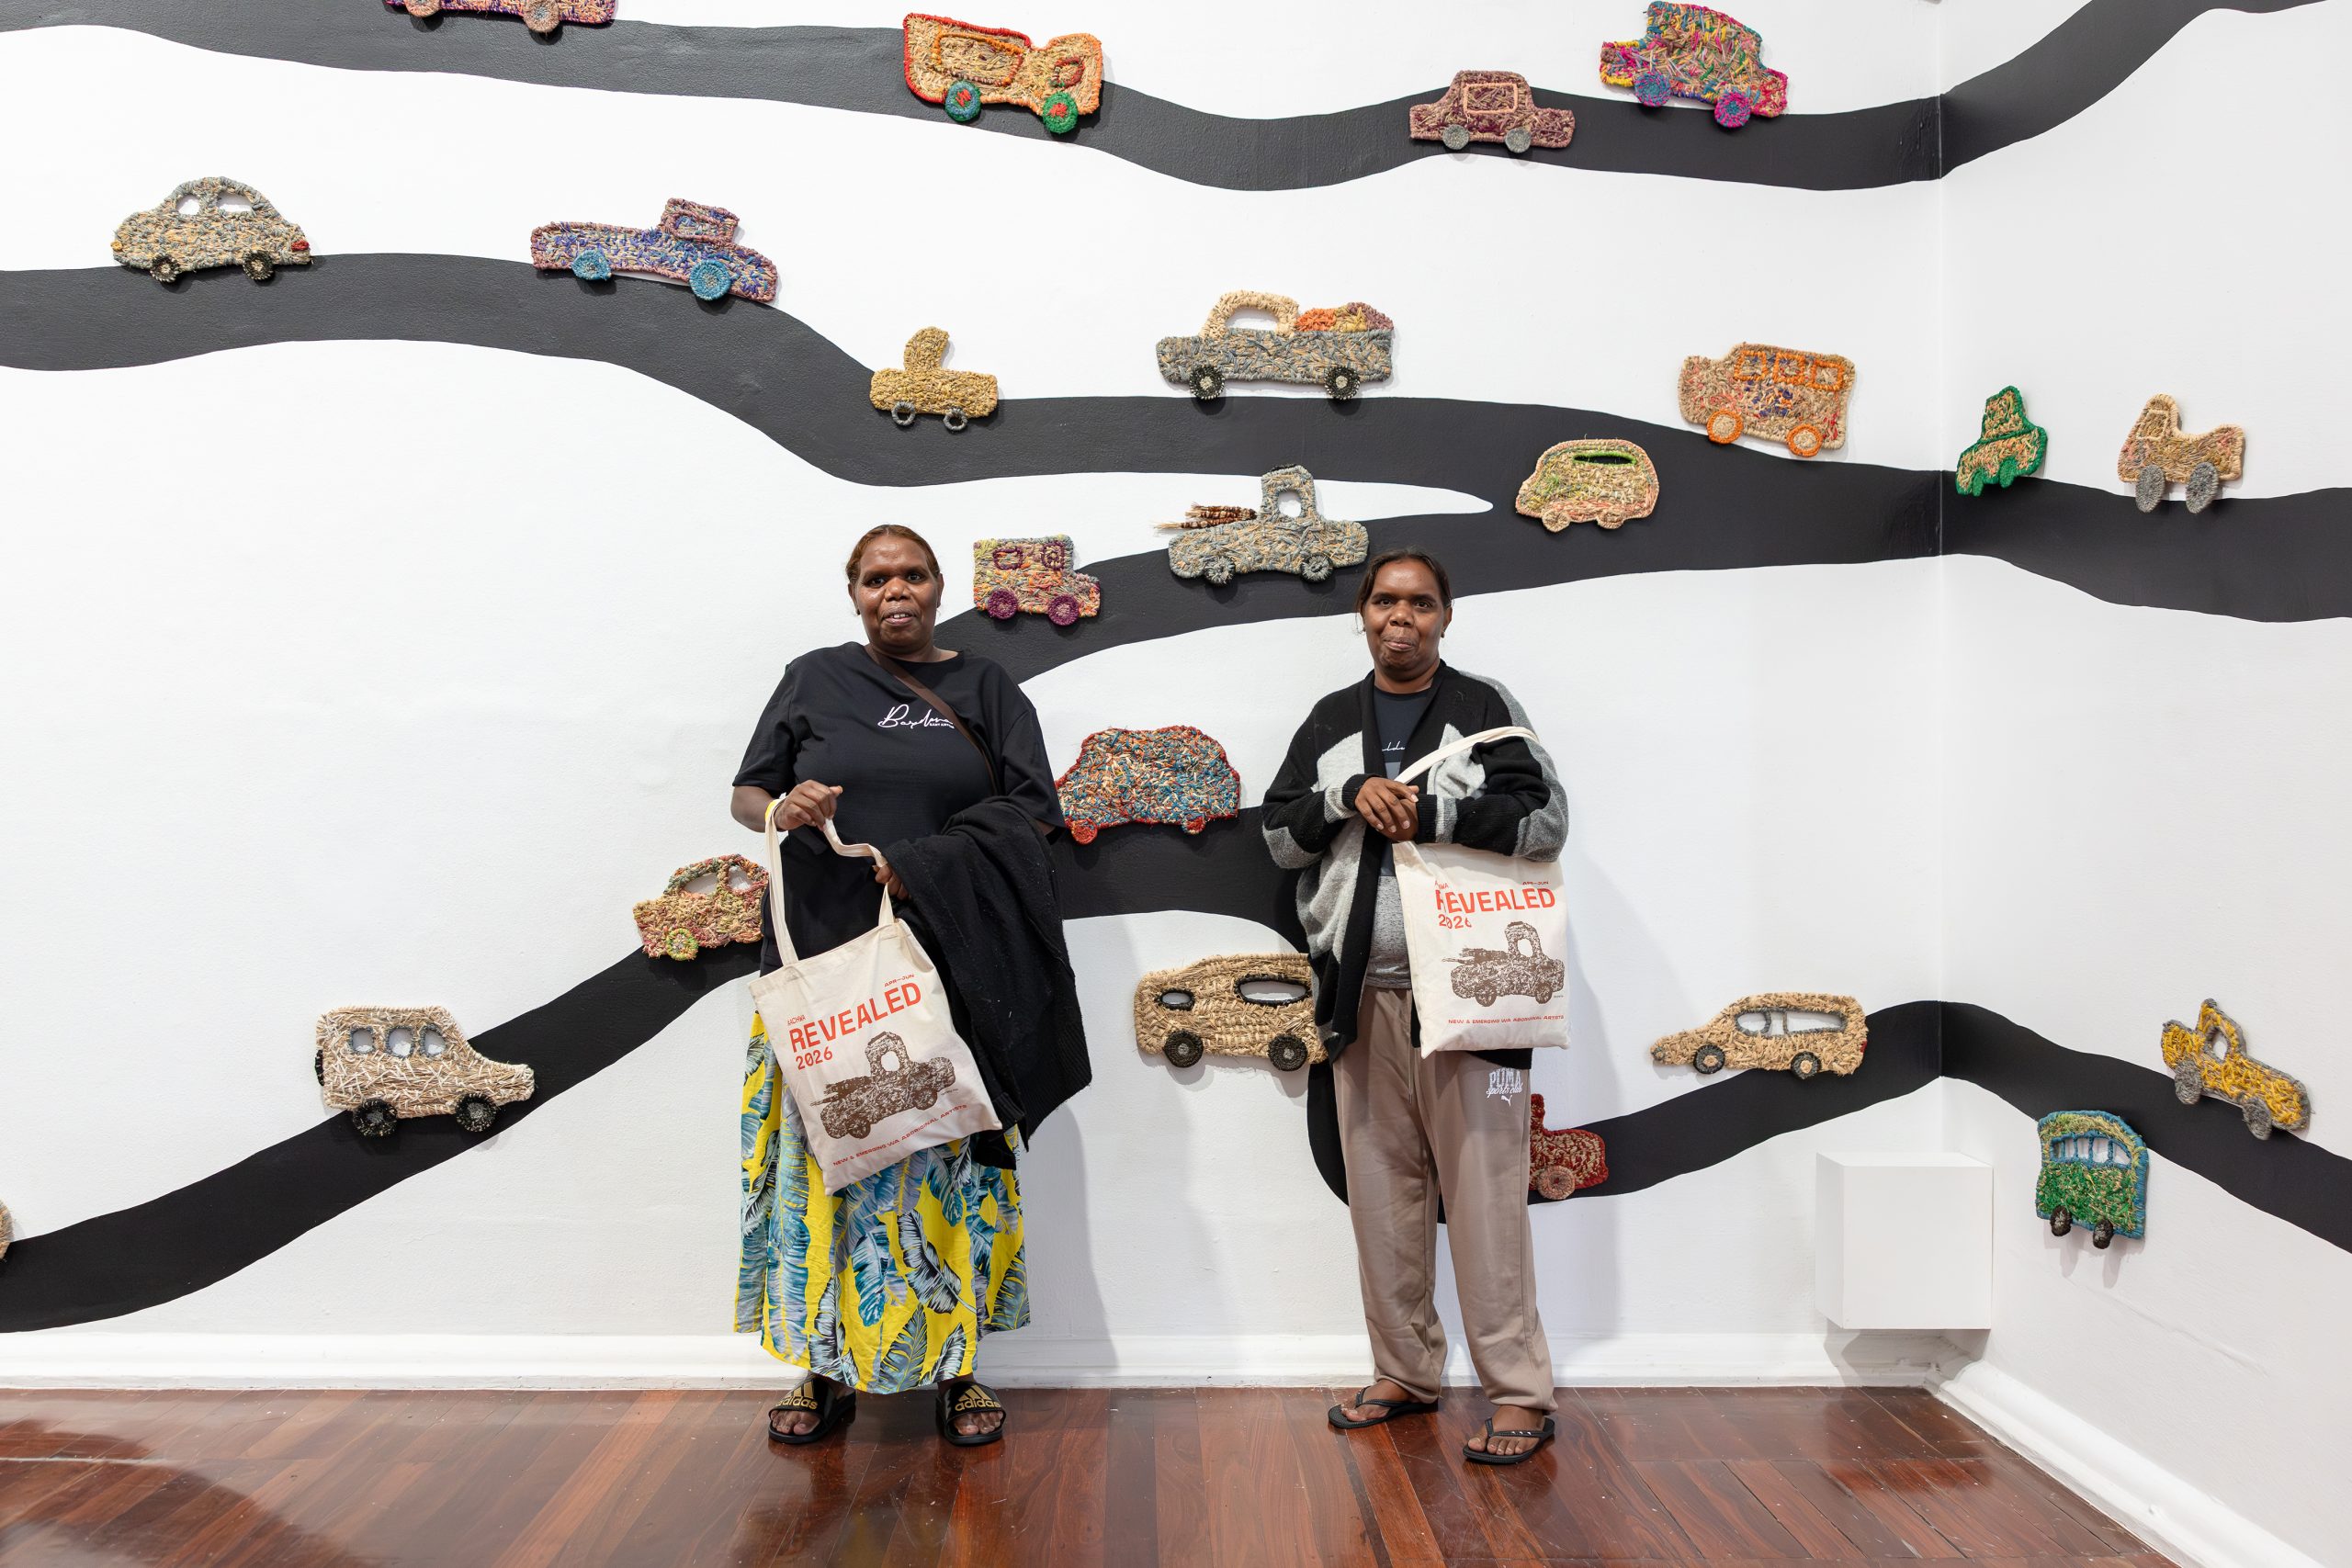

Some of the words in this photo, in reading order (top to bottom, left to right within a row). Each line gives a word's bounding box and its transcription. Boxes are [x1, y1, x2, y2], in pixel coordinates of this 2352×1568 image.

[788, 982, 922, 1054] REVEALED
[796, 1045, 833, 1070] 2026
[1488, 1067, 1521, 1089] PUMA
[832, 1156, 849, 1167] NEW
[855, 1144, 888, 1157] EMERGING
[888, 1139, 900, 1147] WA
[955, 1397, 1001, 1412] adidas
